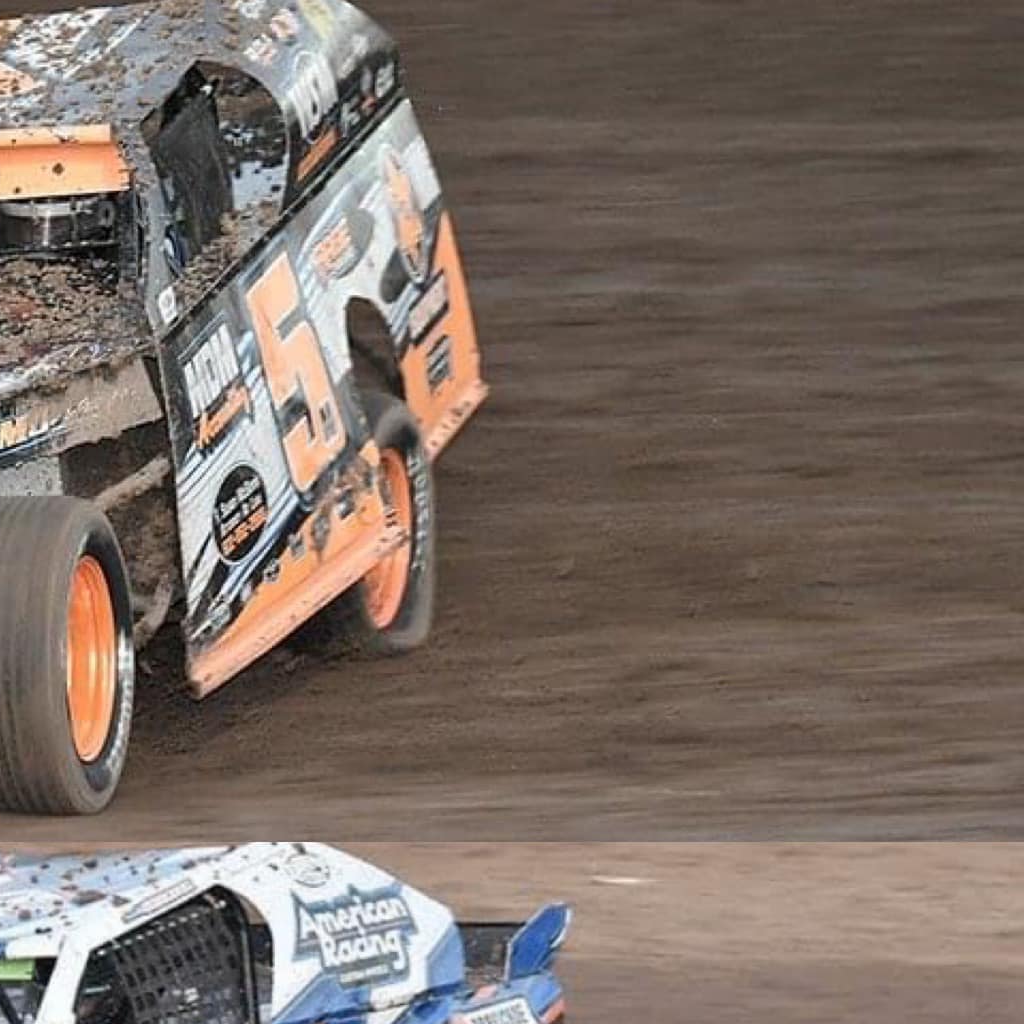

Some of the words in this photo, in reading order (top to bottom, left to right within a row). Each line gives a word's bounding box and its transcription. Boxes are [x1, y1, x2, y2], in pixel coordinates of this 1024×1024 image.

[246, 252, 346, 492] 5
[298, 894, 409, 941] American
[322, 927, 407, 971] Racing
